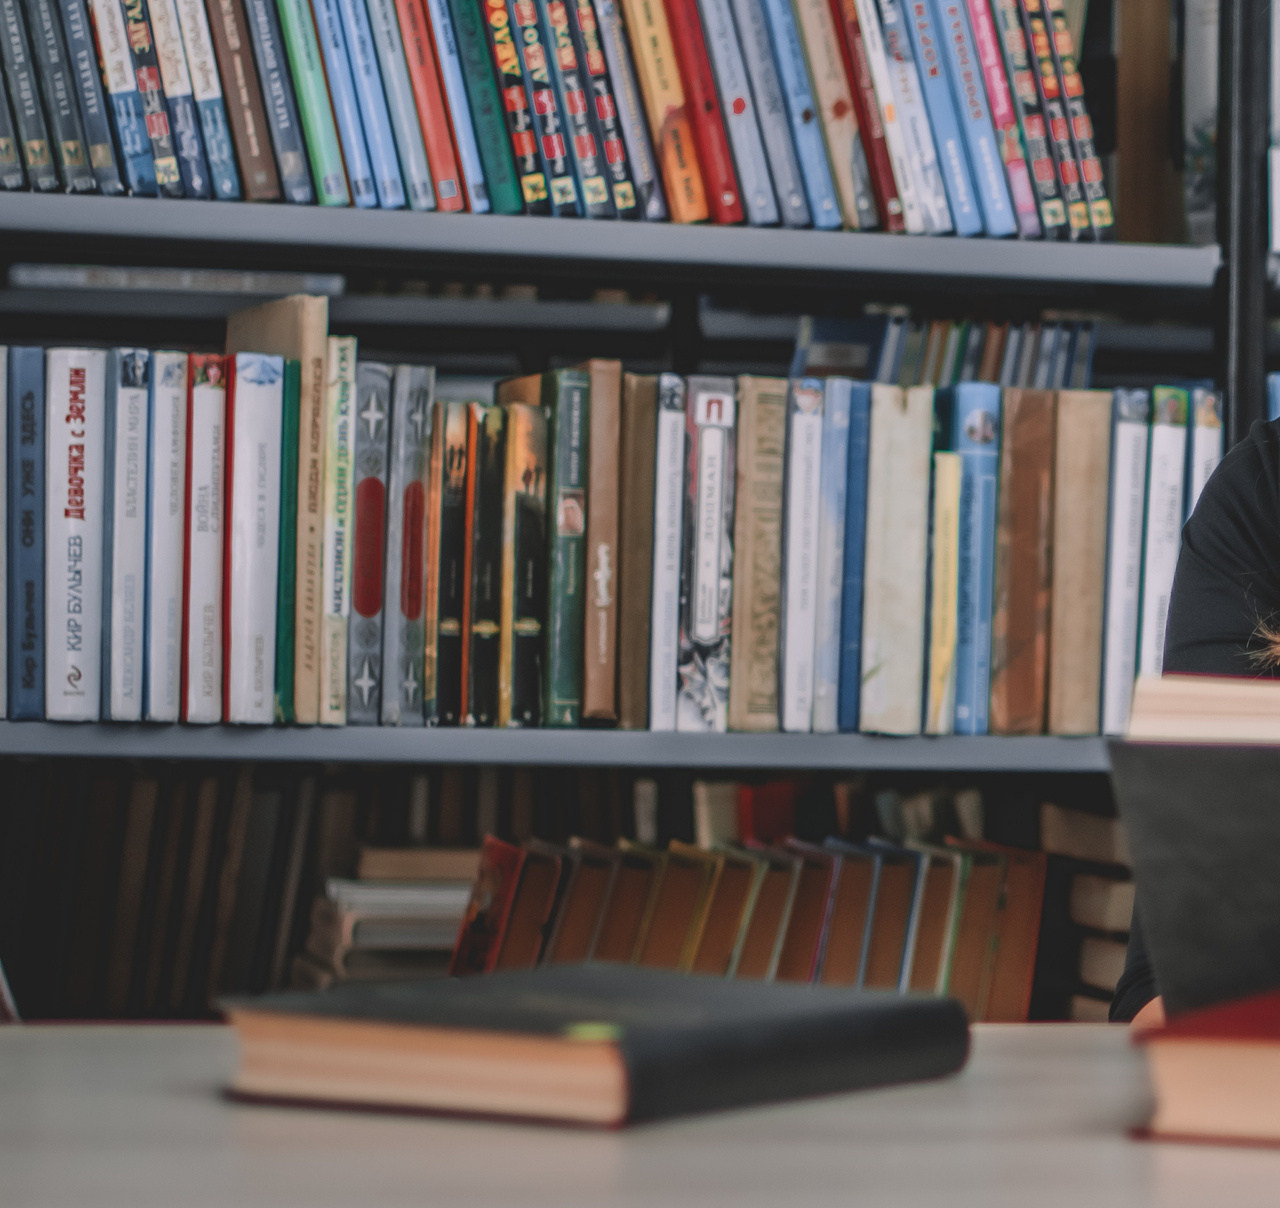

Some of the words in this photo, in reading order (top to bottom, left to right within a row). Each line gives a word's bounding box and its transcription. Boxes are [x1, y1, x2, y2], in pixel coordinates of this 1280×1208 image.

[488, 8, 522, 79] ДЕЛО
[519, 26, 551, 86] ДЕЛО
[948, 6, 983, 120] БРОНЗОВАЯ
[21, 391, 36, 446] ЗДЕСЬ
[65, 367, 87, 424] Земли
[127, 394, 140, 432] МИРА
[706, 399, 723, 422] П
[337, 420, 349, 464] ДЕНЬ
[64, 444, 86, 521] Девочка
[125, 437, 139, 518] ВЛАСТЕЛИН
[211, 424, 221, 517] ЛИЛИПУТАМИ
[308, 458, 319, 513] ЛЮДИ
[336, 466, 348, 513] ОДИН
[22, 509, 35, 548] ОНИ
[195, 486, 209, 532] ВОЙНА
[66, 535, 83, 614] БУЛЫЧЕВ
[334, 531, 345, 615] МИЛЛИОН
[66, 619, 82, 652] КИР
